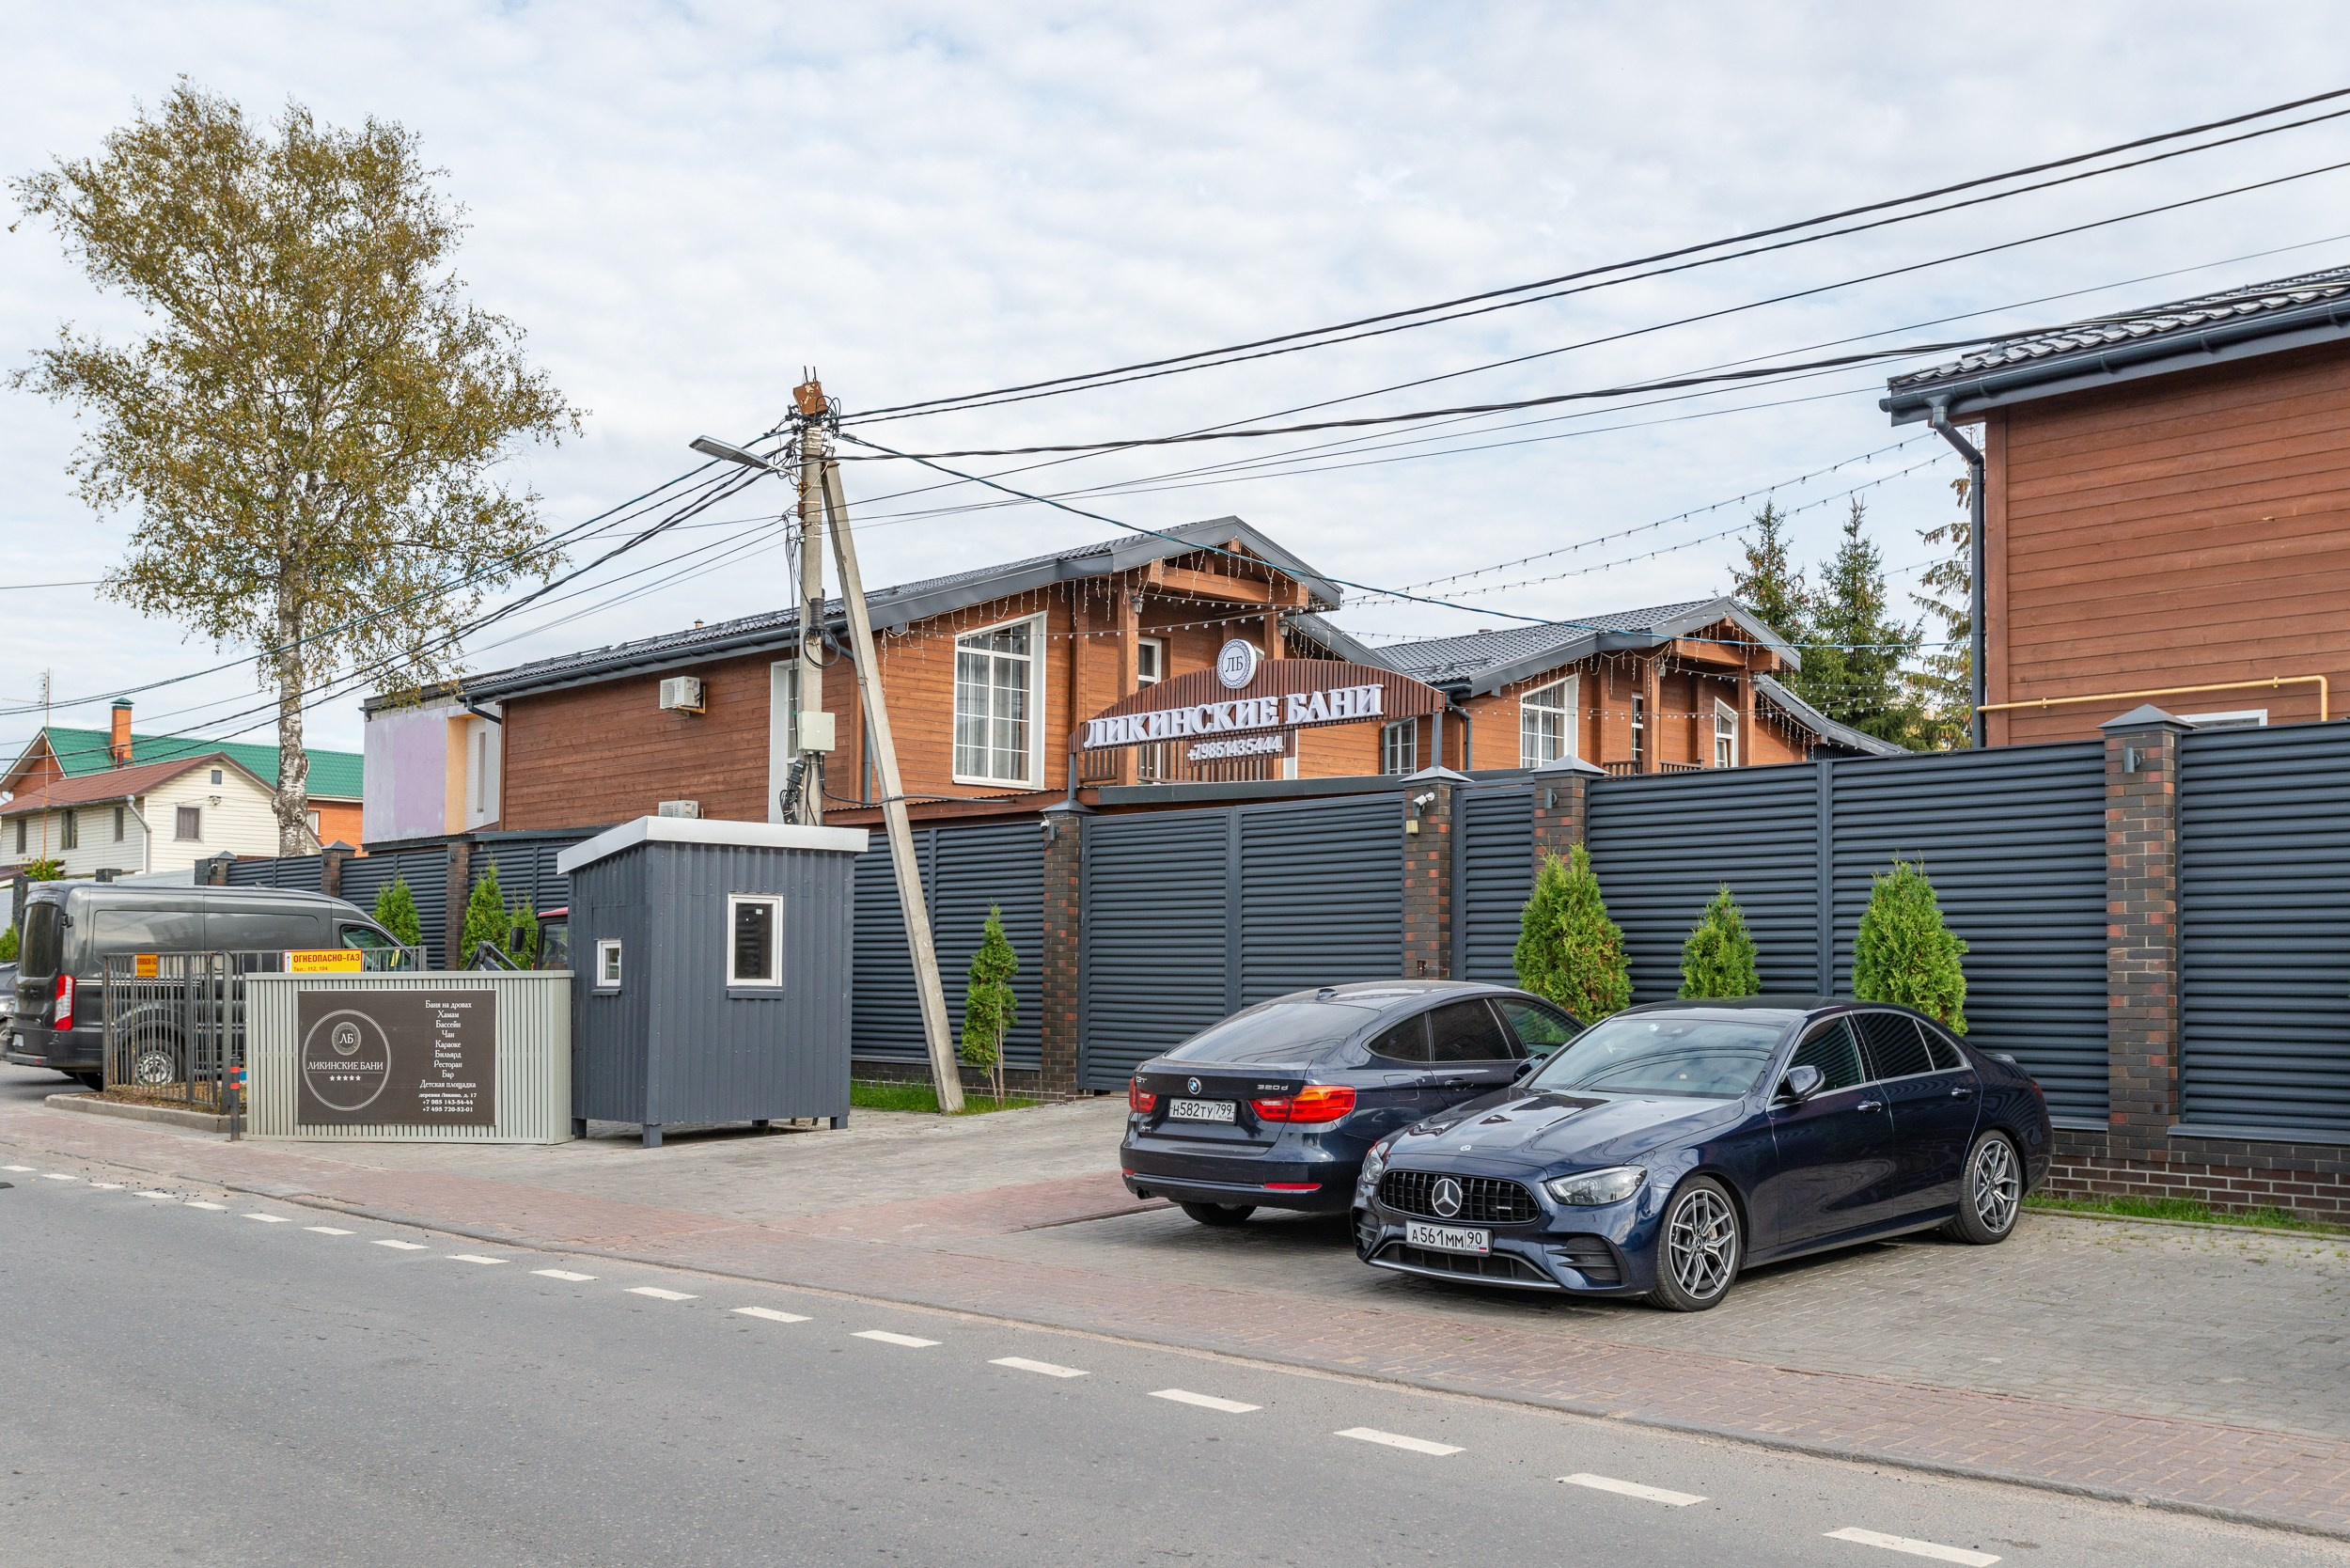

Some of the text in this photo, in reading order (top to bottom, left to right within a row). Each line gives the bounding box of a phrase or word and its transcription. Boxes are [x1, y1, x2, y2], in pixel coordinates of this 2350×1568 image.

[1225, 655, 1244, 673] ЛБ
[1084, 683, 1385, 748] ЛИКИНСКИЕ БАНИ
[1187, 735, 1284, 760] +79851435444
[293, 953, 360, 963] ОГНЕОПАСНО-ГАЗ
[425, 999, 441, 1008] Баня
[437, 1010, 460, 1018] Хамам
[435, 1019, 461, 1028] Бассейн
[339, 1033, 354, 1043] ЛБ
[442, 1029, 455, 1038] Чан
[435, 1040, 462, 1049] Караоке
[434, 1050, 462, 1059] Бильярд
[307, 1061, 359, 1070] ЛИКИНСКИЕ
[433, 1059, 462, 1069] Ресторан
[442, 1070, 455, 1079] Бар
[419, 1079, 446, 1089] Детская
[1467, 1231, 1482, 1245] 90
